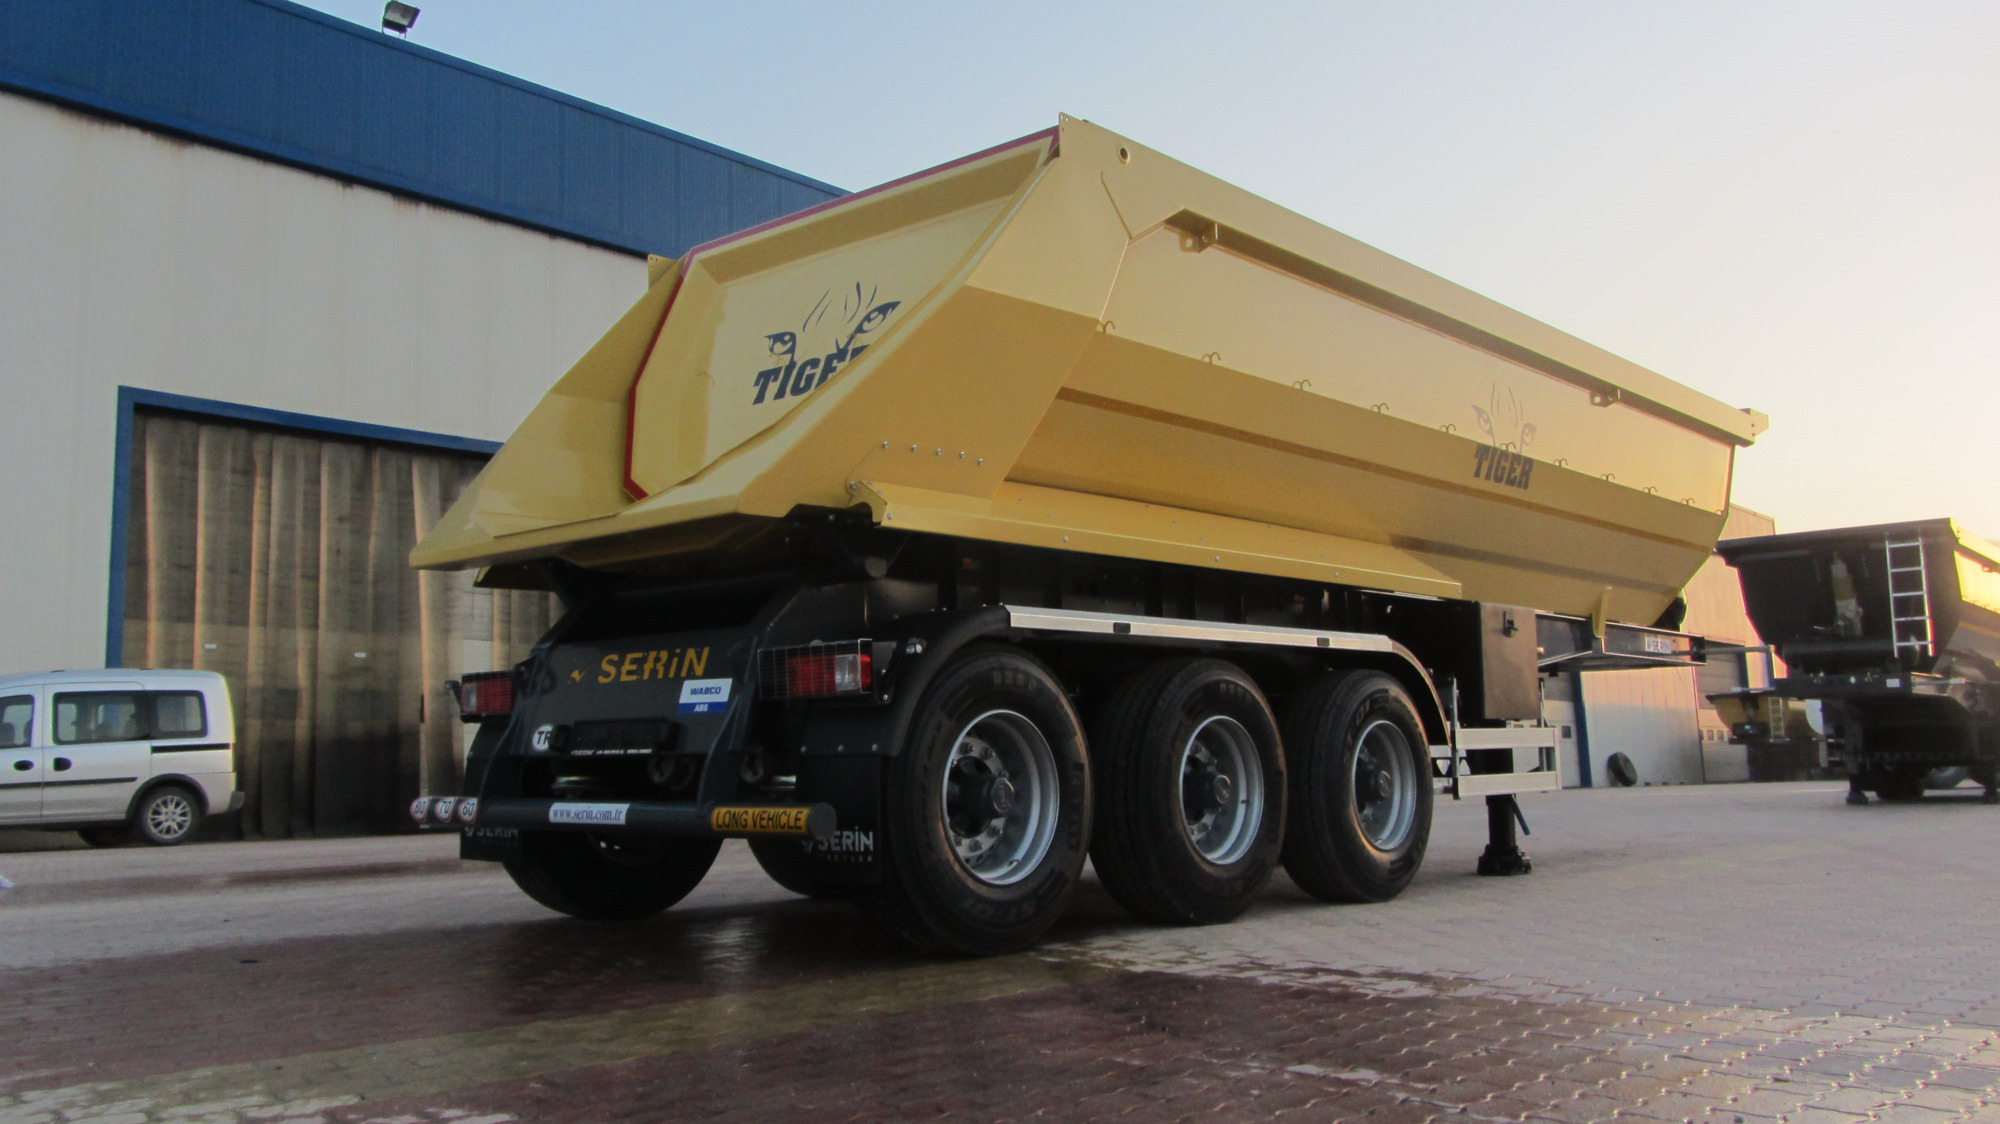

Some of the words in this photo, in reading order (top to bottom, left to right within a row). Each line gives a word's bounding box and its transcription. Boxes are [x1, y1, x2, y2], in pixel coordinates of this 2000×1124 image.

[1474, 444, 1533, 489] TIGER
[690, 686, 722, 696] WABCO
[693, 703, 709, 713] ABS
[414, 800, 426, 815] 80
[439, 800, 452, 815] 70
[462, 802, 474, 816] 60
[552, 806, 623, 821] www.serin.com.tr
[716, 810, 748, 829] LONG
[752, 810, 804, 830] VEHICLE
